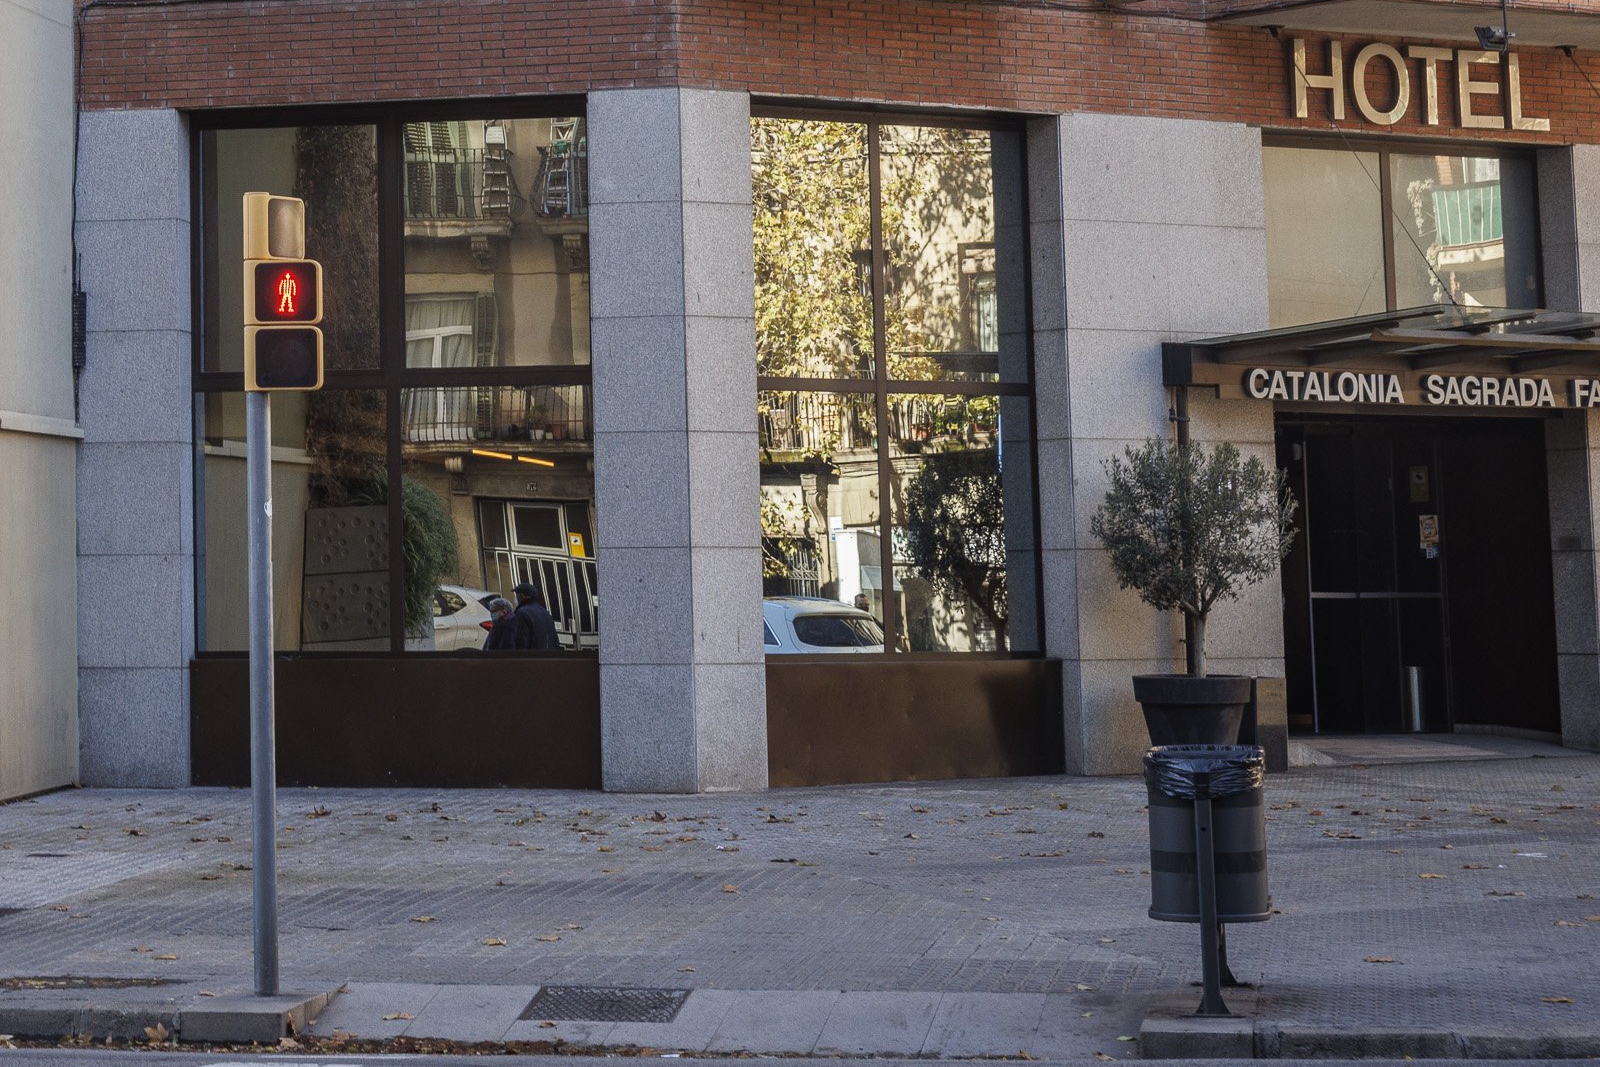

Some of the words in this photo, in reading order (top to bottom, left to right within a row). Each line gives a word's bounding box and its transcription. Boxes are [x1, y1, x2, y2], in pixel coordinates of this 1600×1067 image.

[1293, 38, 1550, 132] HOTEL
[1249, 368, 1405, 404] CATALONIA
[1427, 374, 1556, 407] SAGRADA
